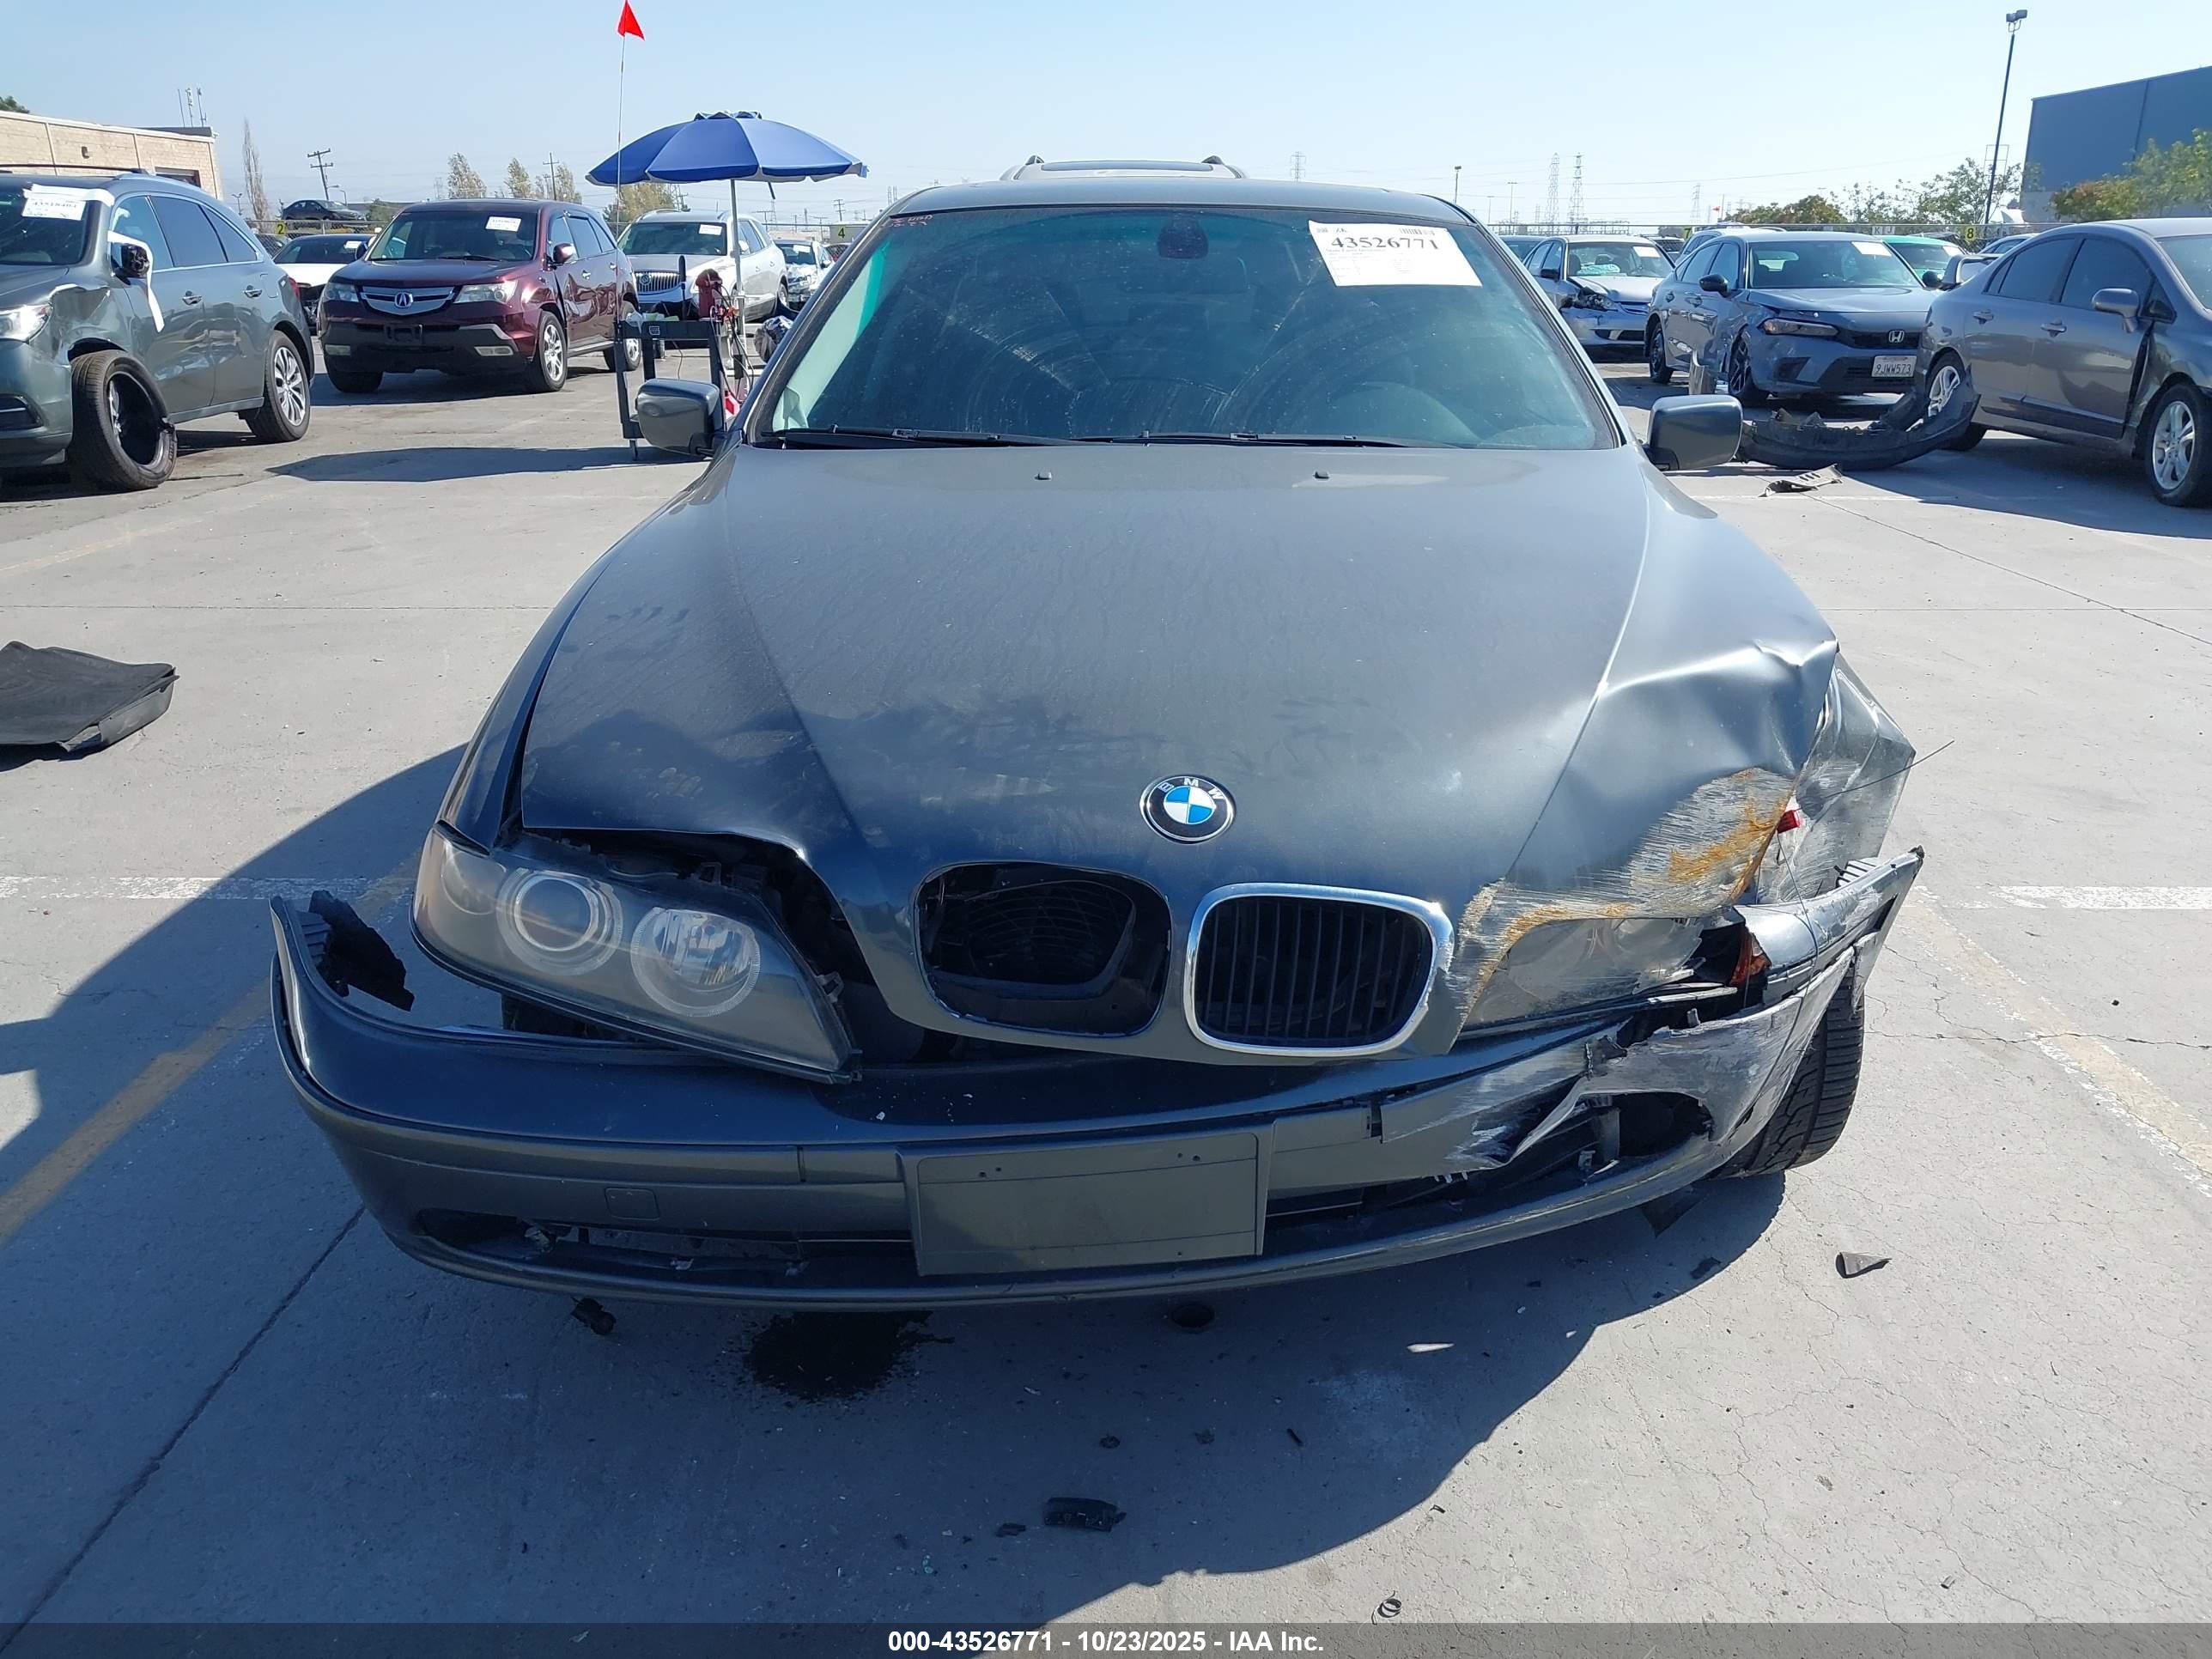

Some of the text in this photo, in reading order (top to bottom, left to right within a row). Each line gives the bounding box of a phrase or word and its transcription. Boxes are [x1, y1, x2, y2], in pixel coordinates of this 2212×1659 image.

[276, 223, 285, 235] 2
[837, 227, 846, 239] 4
[1966, 228, 1974, 240] 8
[1331, 235, 1439, 250] 43526771
[1875, 363, 1912, 374] 9JWW573
[1157, 777, 1226, 800] BMW
